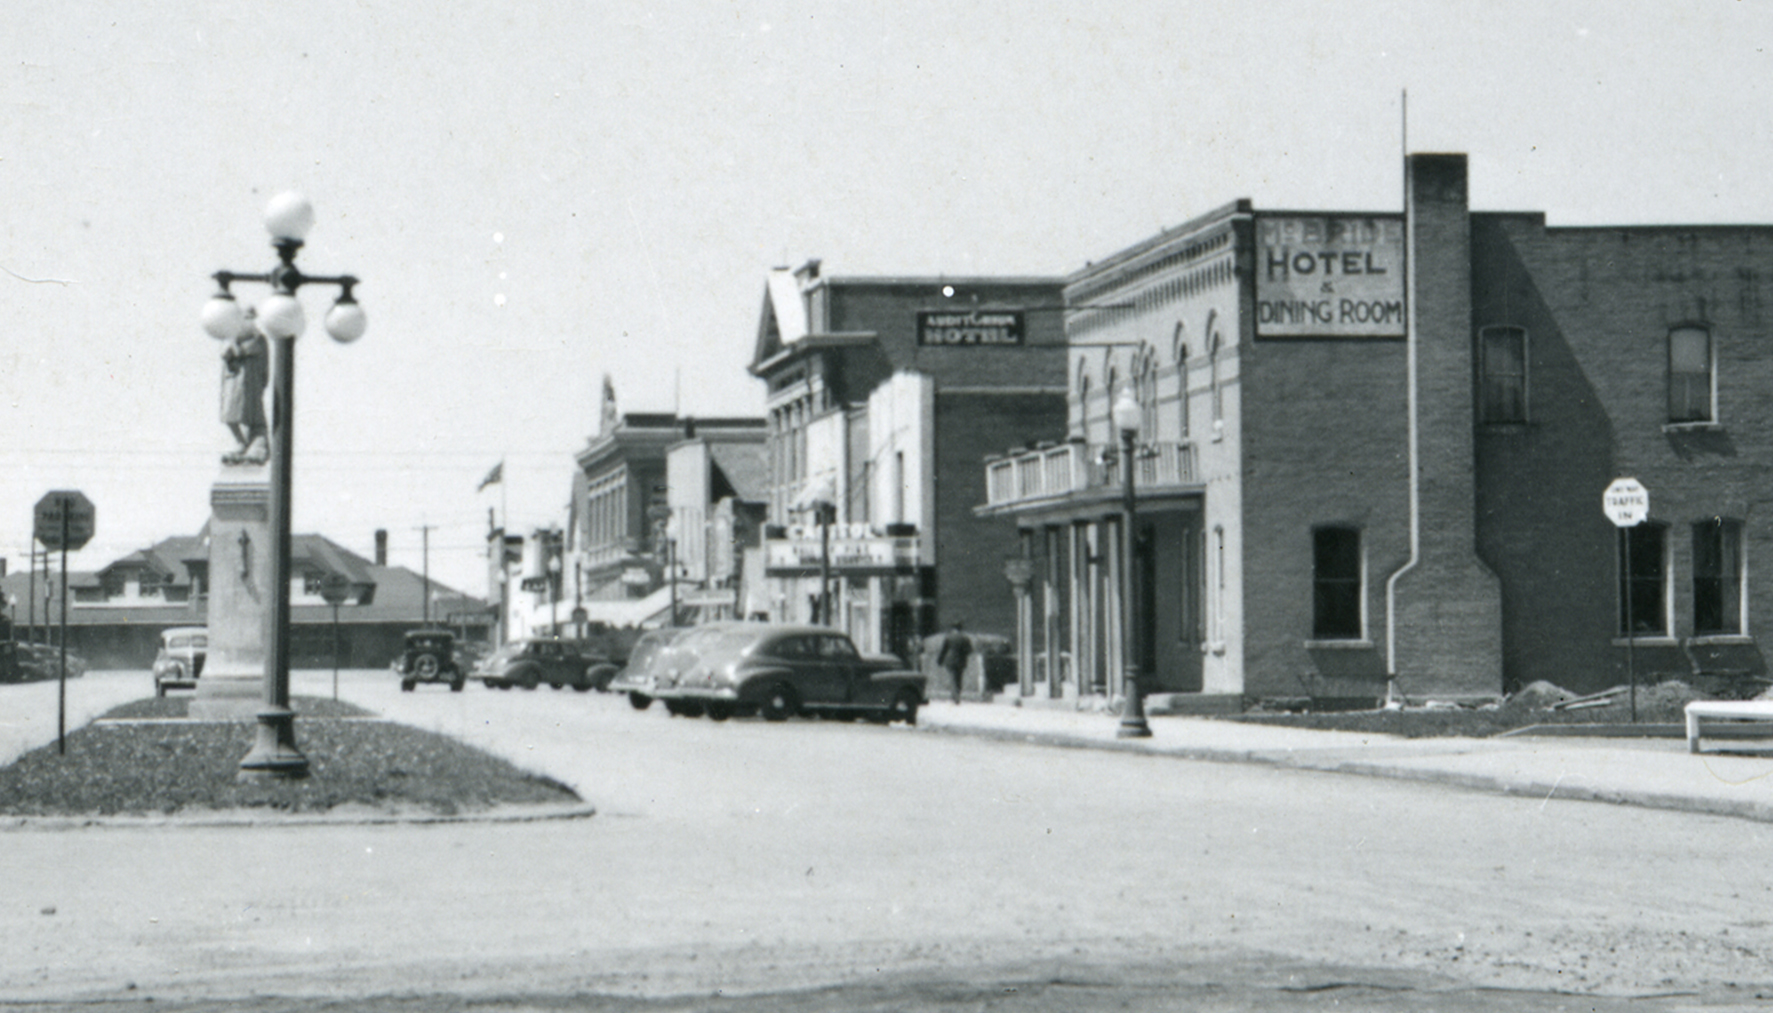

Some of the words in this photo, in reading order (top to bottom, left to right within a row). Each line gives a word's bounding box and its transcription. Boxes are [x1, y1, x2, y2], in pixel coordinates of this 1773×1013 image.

[1266, 247, 1386, 282] HOTEL
[1319, 280, 1335, 293] &
[1259, 300, 1333, 324] DINING
[1339, 298, 1403, 324] ROOM
[924, 328, 1018, 343] HOTEL
[1606, 496, 1644, 506] TRAFFIC
[1618, 511, 1633, 521] IN
